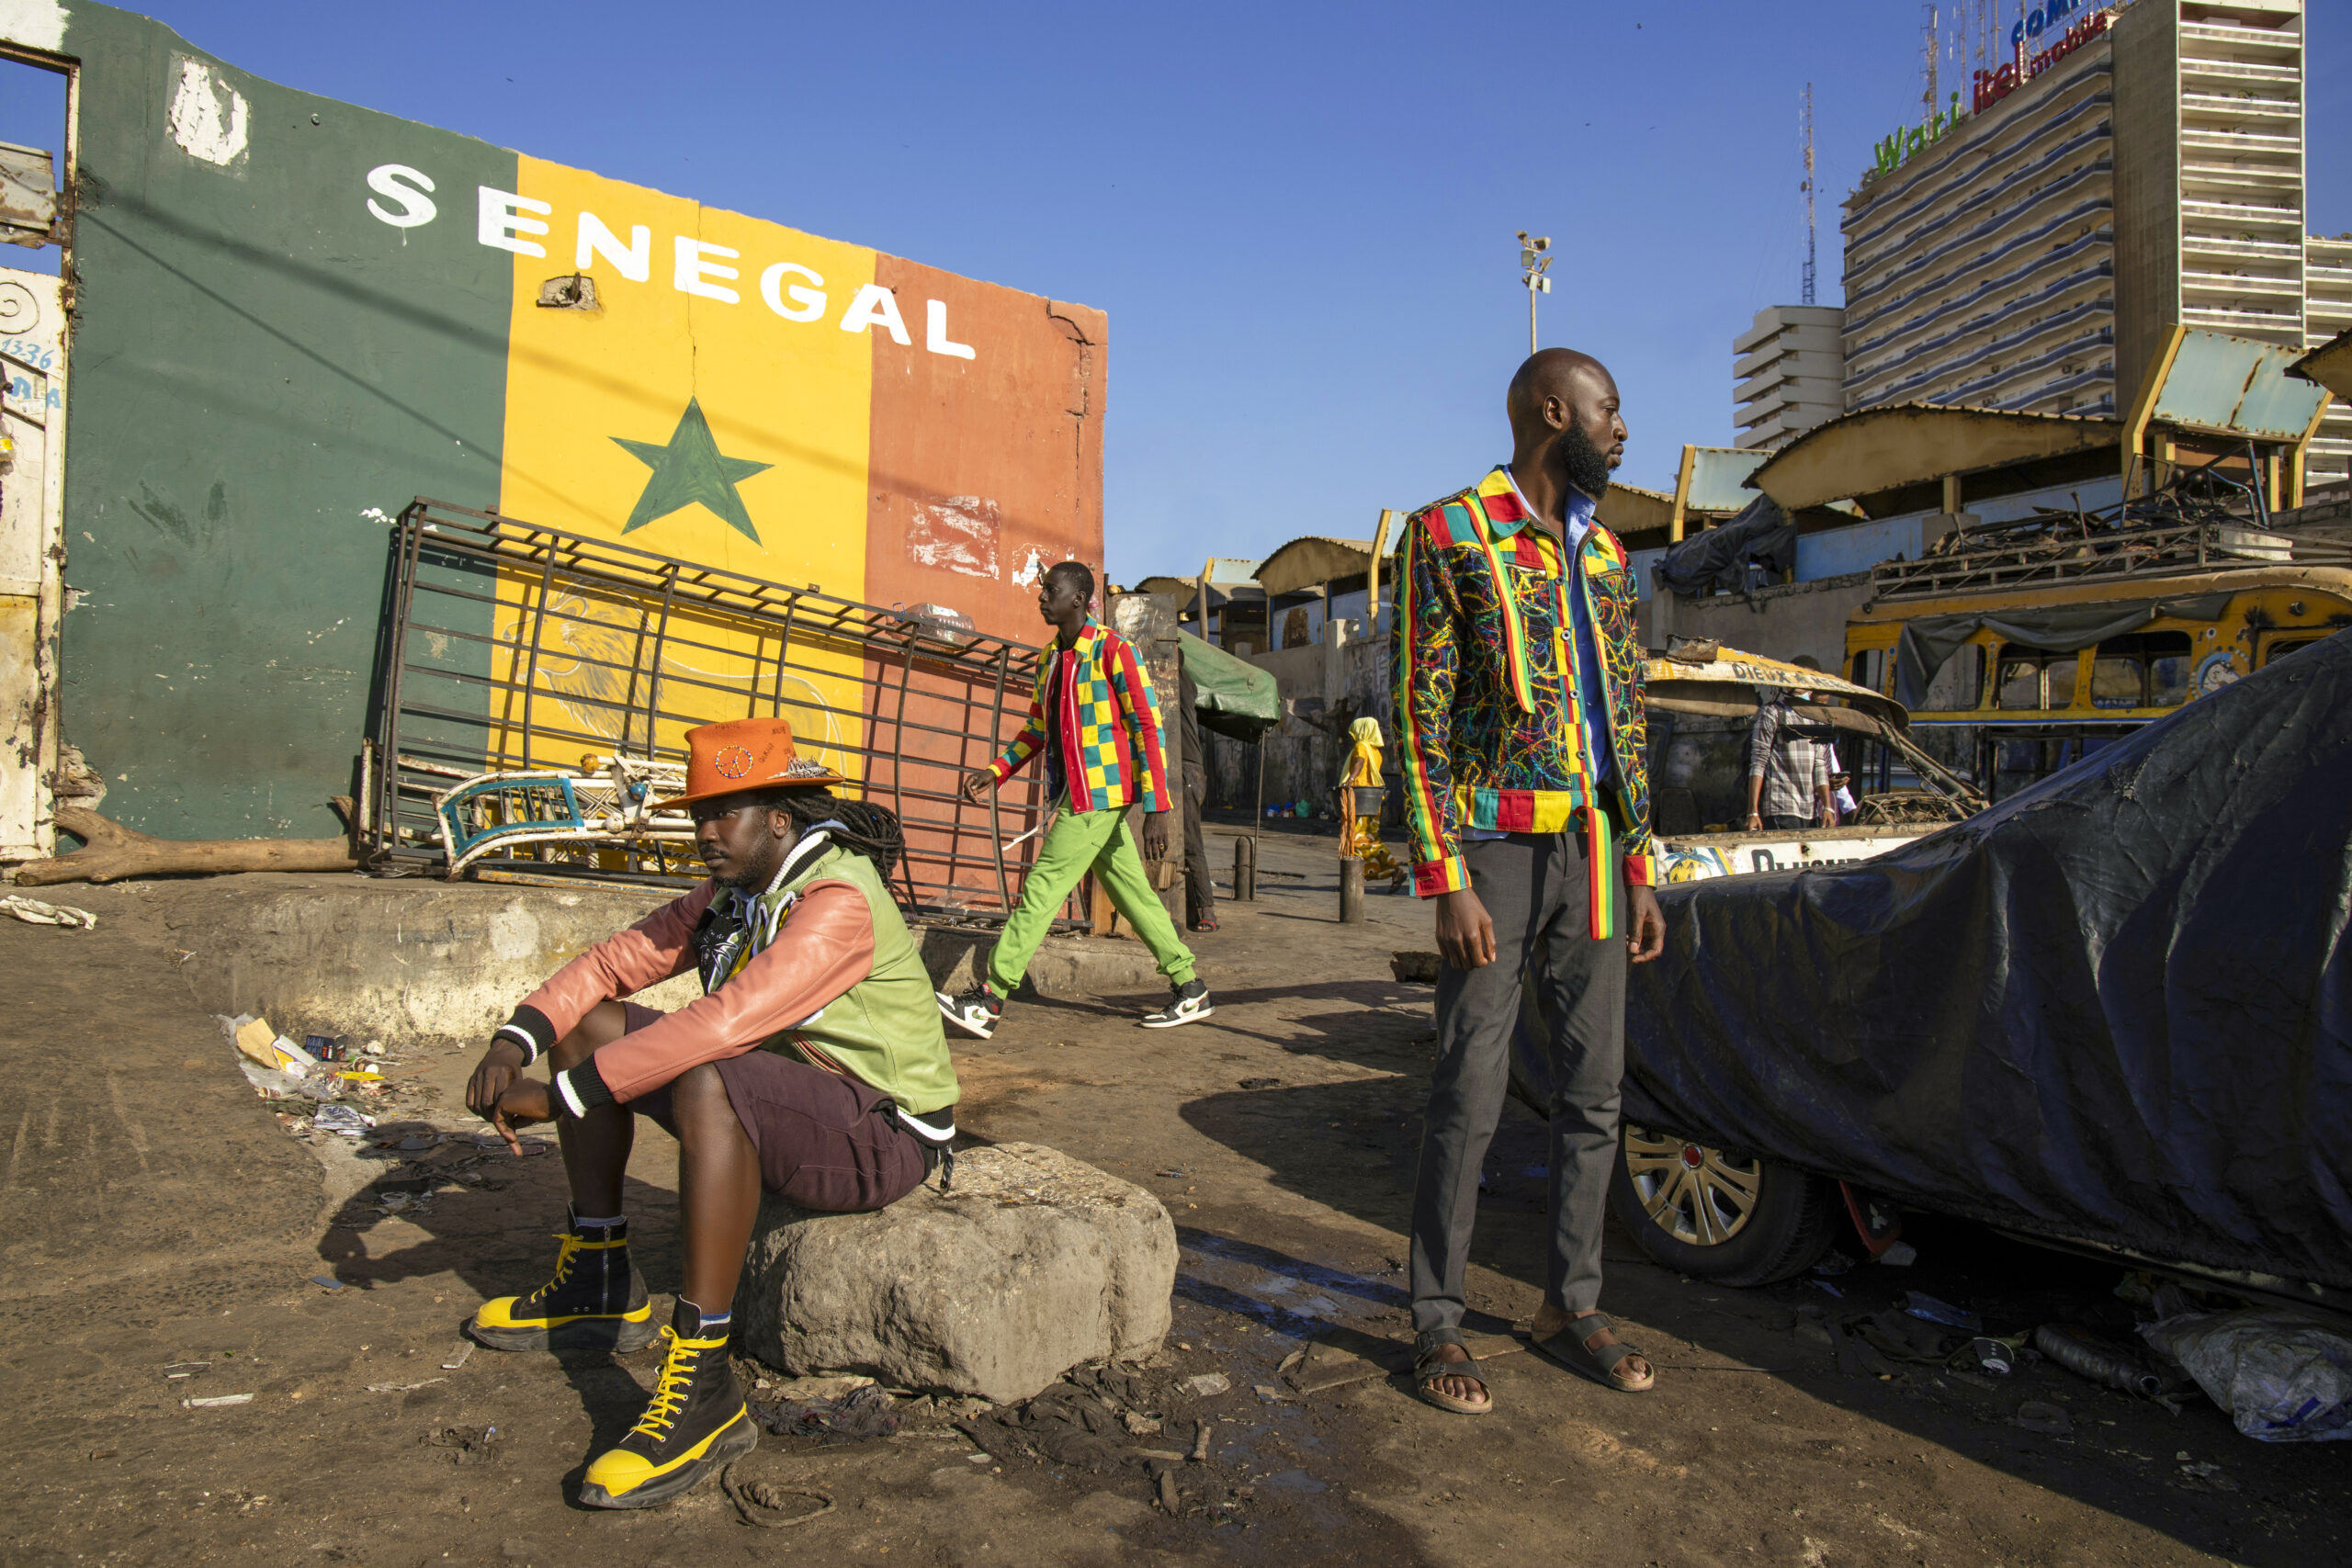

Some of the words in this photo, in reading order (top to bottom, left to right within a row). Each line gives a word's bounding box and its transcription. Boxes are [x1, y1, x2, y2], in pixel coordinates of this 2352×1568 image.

[1973, 40, 2024, 116] itel
[2030, 11, 2108, 79] mobile
[2010, 0, 2082, 47] COM
[1874, 91, 1960, 178] Wari
[366, 163, 977, 360] SENEGAL
